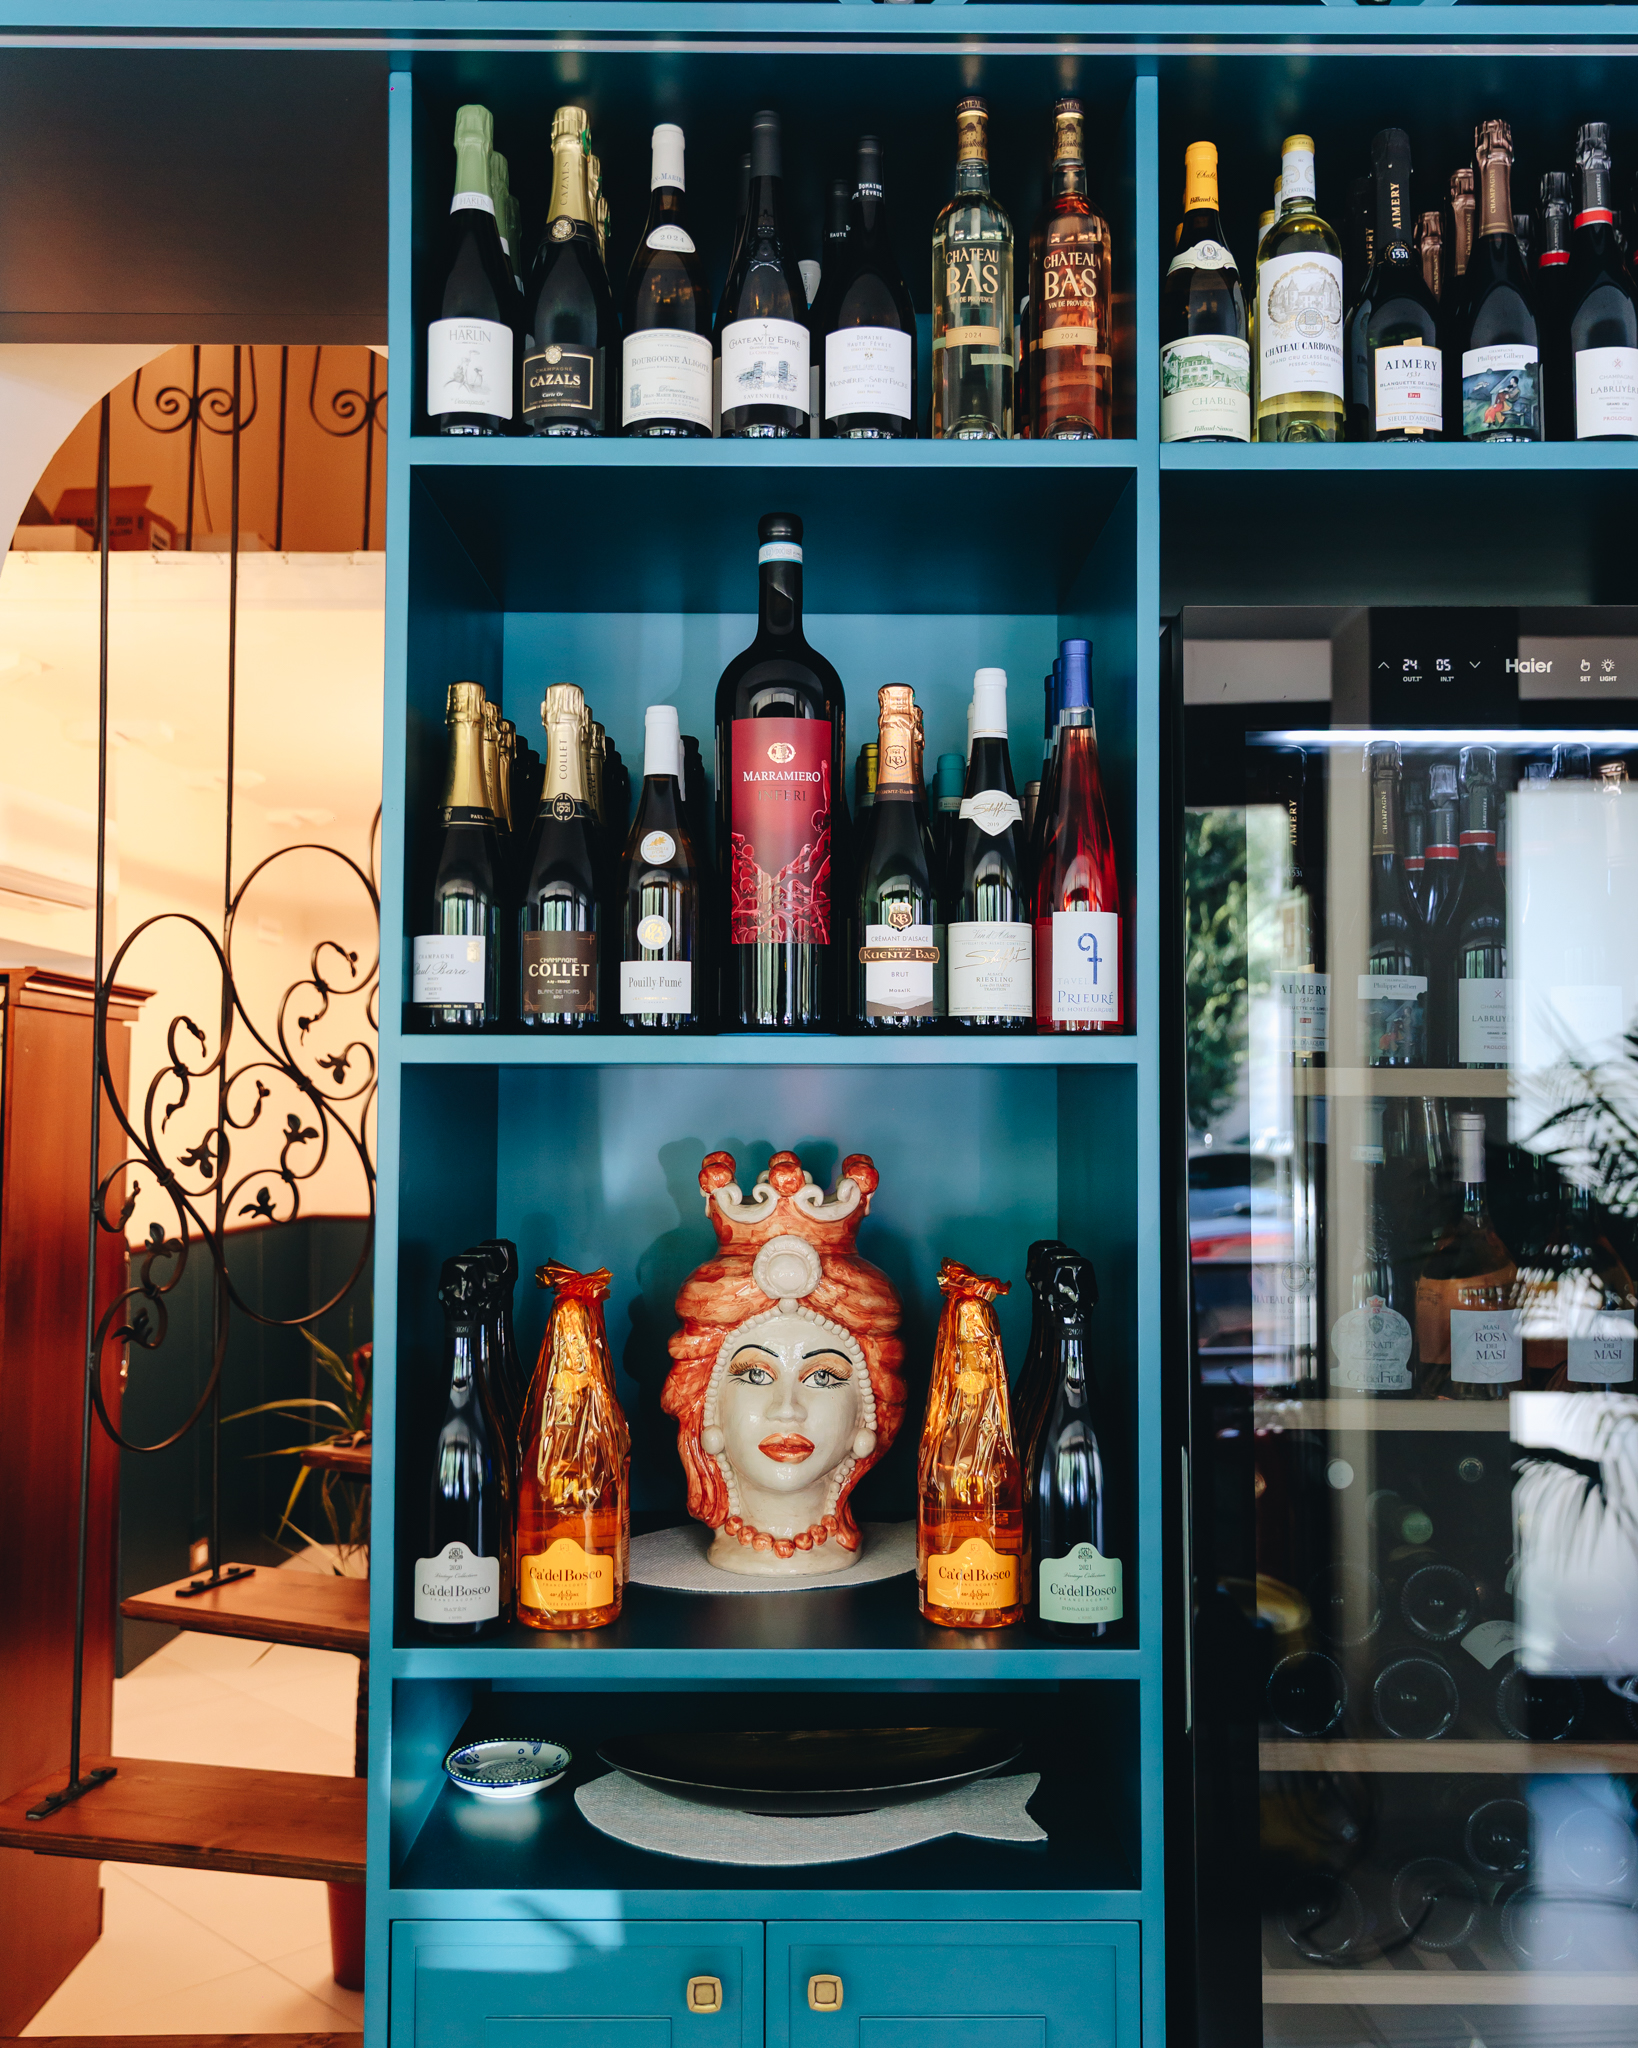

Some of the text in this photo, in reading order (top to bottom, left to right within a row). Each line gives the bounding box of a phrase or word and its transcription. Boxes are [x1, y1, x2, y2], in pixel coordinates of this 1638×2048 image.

[560, 162, 570, 206] CAZALS
[862, 190, 882, 198] FÉVRIE
[1390, 182, 1401, 229] AIMERY
[660, 234, 684, 242] 2024
[945, 247, 999, 265] CHÂTEAU
[1044, 252, 1098, 269] CHÂTEAU
[946, 263, 999, 296] BAS
[1044, 268, 1097, 301] BAS
[1048, 301, 1058, 309] VIN
[1066, 300, 1094, 308] PROVENCE
[449, 329, 491, 342] HARLIN
[1265, 342, 1300, 358] CHÂTEAU
[631, 356, 680, 367] BOURGOGNE
[682, 356, 710, 373] ALIGOTÉ
[1269, 357, 1286, 366] GRAND
[1385, 359, 1437, 371] AIMERY
[536, 366, 573, 374] CHAMPAGNE
[530, 374, 581, 388] CAZALS
[890, 378, 908, 389] FIACRE
[1192, 397, 1236, 406] CHABLIS
[1403, 659, 1418, 671] 24
[1506, 658, 1553, 673] Haier
[559, 739, 567, 780] COLLET
[743, 771, 820, 782] MARRAMIERO
[758, 790, 806, 801] INFERI
[557, 806, 570, 814] 1921
[1289, 799, 1298, 846] AIMERY
[973, 929, 985, 939] Vin
[432, 961, 469, 975] Bara
[528, 963, 590, 977] COLLET
[1280, 985, 1327, 996] AIMERY
[1057, 990, 1114, 1005] PRIEURÉ
[1475, 1333, 1507, 1342] ROSA
[1476, 1350, 1506, 1359] MASI
[1594, 1350, 1622, 1359] MASI
[565, 1569, 602, 1581] Bosco
[976, 1569, 1010, 1581] Bosco
[456, 1584, 491, 1597] Bosco
[1086, 1585, 1117, 1596] Bosco
